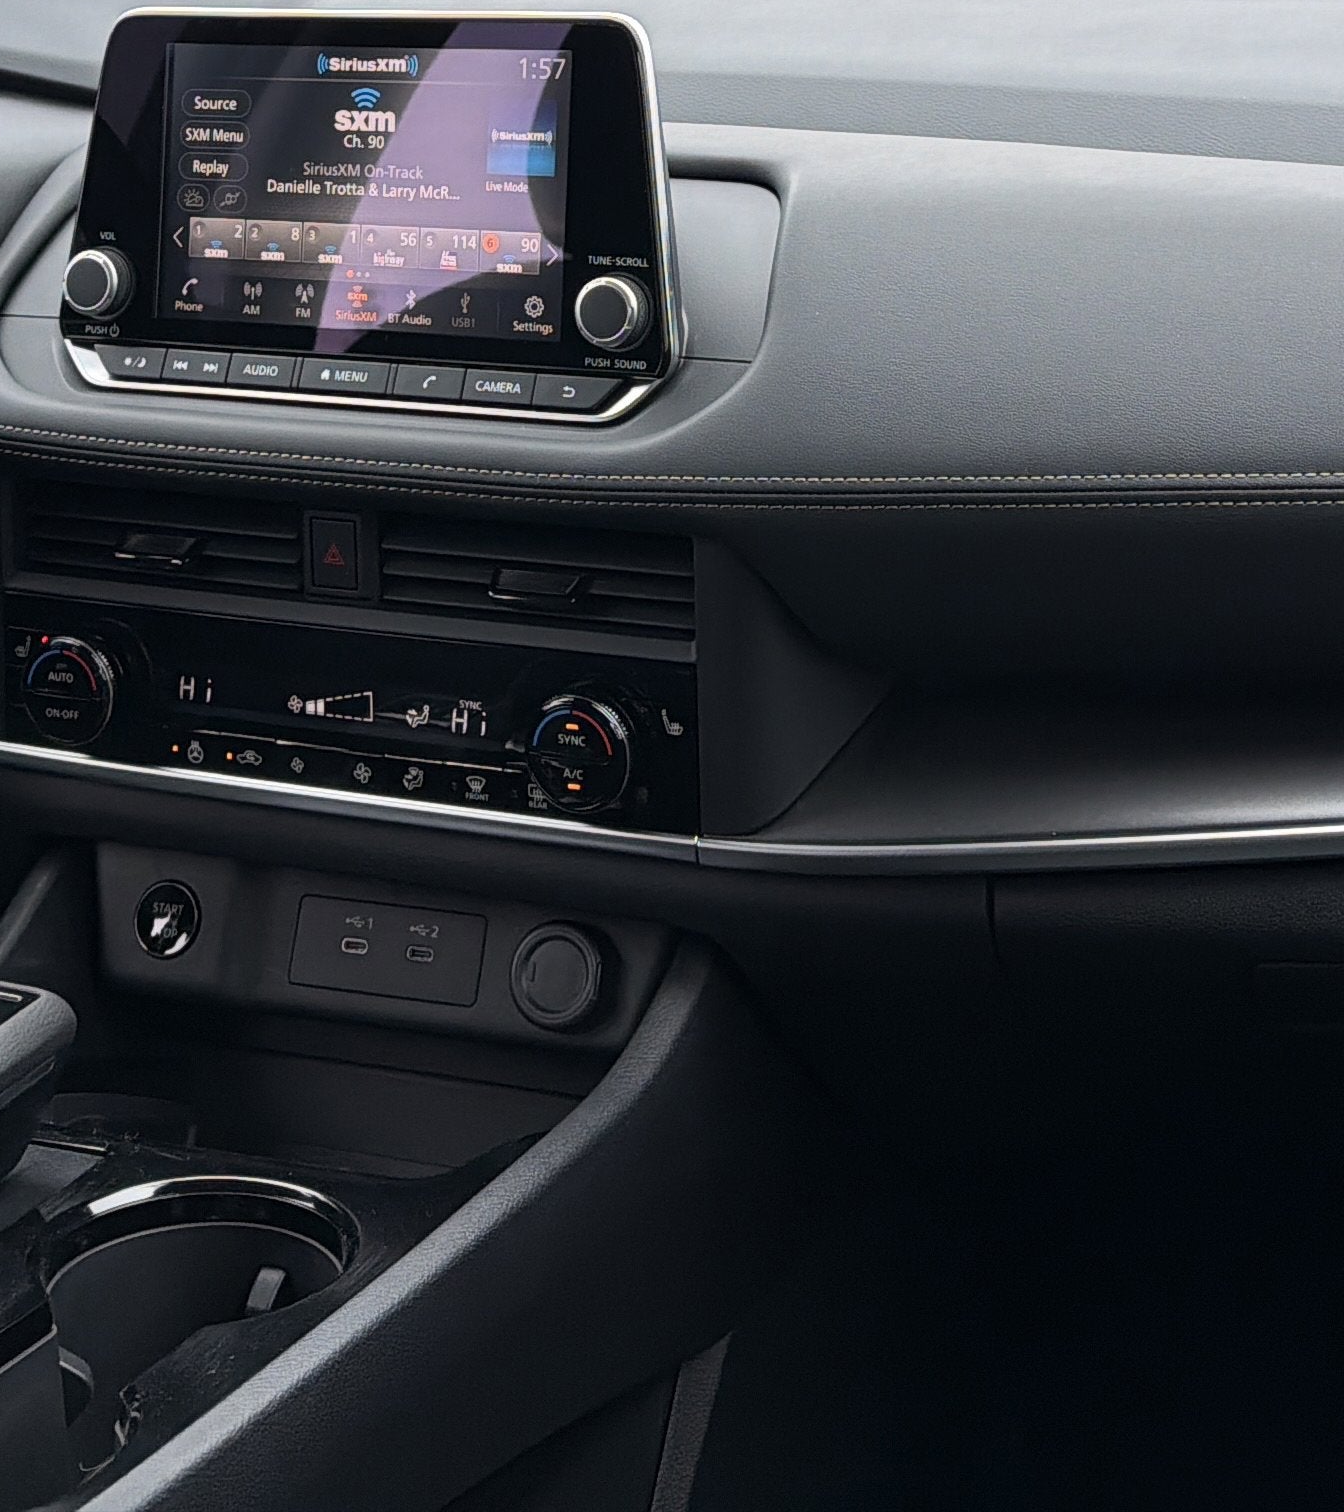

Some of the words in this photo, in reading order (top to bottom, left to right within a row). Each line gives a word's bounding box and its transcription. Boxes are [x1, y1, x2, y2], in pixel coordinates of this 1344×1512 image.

[519, 56, 567, 80] 1:57
[194, 95, 238, 111] Source
[185, 128, 210, 142] SXM
[212, 128, 244, 143] Menu
[343, 135, 365, 149] Ch.
[367, 135, 385, 150] 90
[192, 159, 229, 178] Replay
[303, 161, 360, 178] SiriusXM
[364, 164, 424, 180] On-Track
[267, 179, 321, 195] Danielle
[324, 181, 365, 197] Trotta
[368, 183, 379, 197] &
[382, 184, 415, 201] Larry
[420, 185, 461, 201] McR...
[485, 180, 503, 192] Live
[504, 182, 529, 194] Mode
[99, 230, 117, 241] VOL
[234, 224, 243, 238] 2
[251, 227, 258, 238] 2
[291, 227, 300, 241] 8
[309, 230, 316, 241] 3
[350, 230, 356, 244] 1
[366, 232, 374, 242] 4
[400, 232, 417, 247] 56
[426, 235, 433, 246] 5
[452, 235, 477, 250] 114
[521, 238, 540, 253] 90
[174, 300, 204, 312] Phone
[242, 304, 260, 315] AM
[295, 307, 311, 318] FM
[335, 309, 377, 322] SiriusXM
[387, 312, 400, 324] BT
[402, 312, 432, 326] Audio
[451, 316, 476, 329] USB1
[85, 324, 108, 335] PUSH
[512, 320, 553, 336] Settings
[243, 363, 279, 377] AUDIO
[584, 356, 611, 368] PUSH
[614, 357, 647, 370] SOUND
[334, 370, 369, 383] MENU
[475, 379, 522, 394] CAMERA
[48, 671, 74, 684] AUTO
[179, 675, 212, 703] Hi
[458, 699, 483, 711] SYNC
[557, 734, 587, 747] SYNC
[563, 768, 584, 780] A/C
[464, 792, 489, 802] FRONT
[152, 902, 185, 915] START
